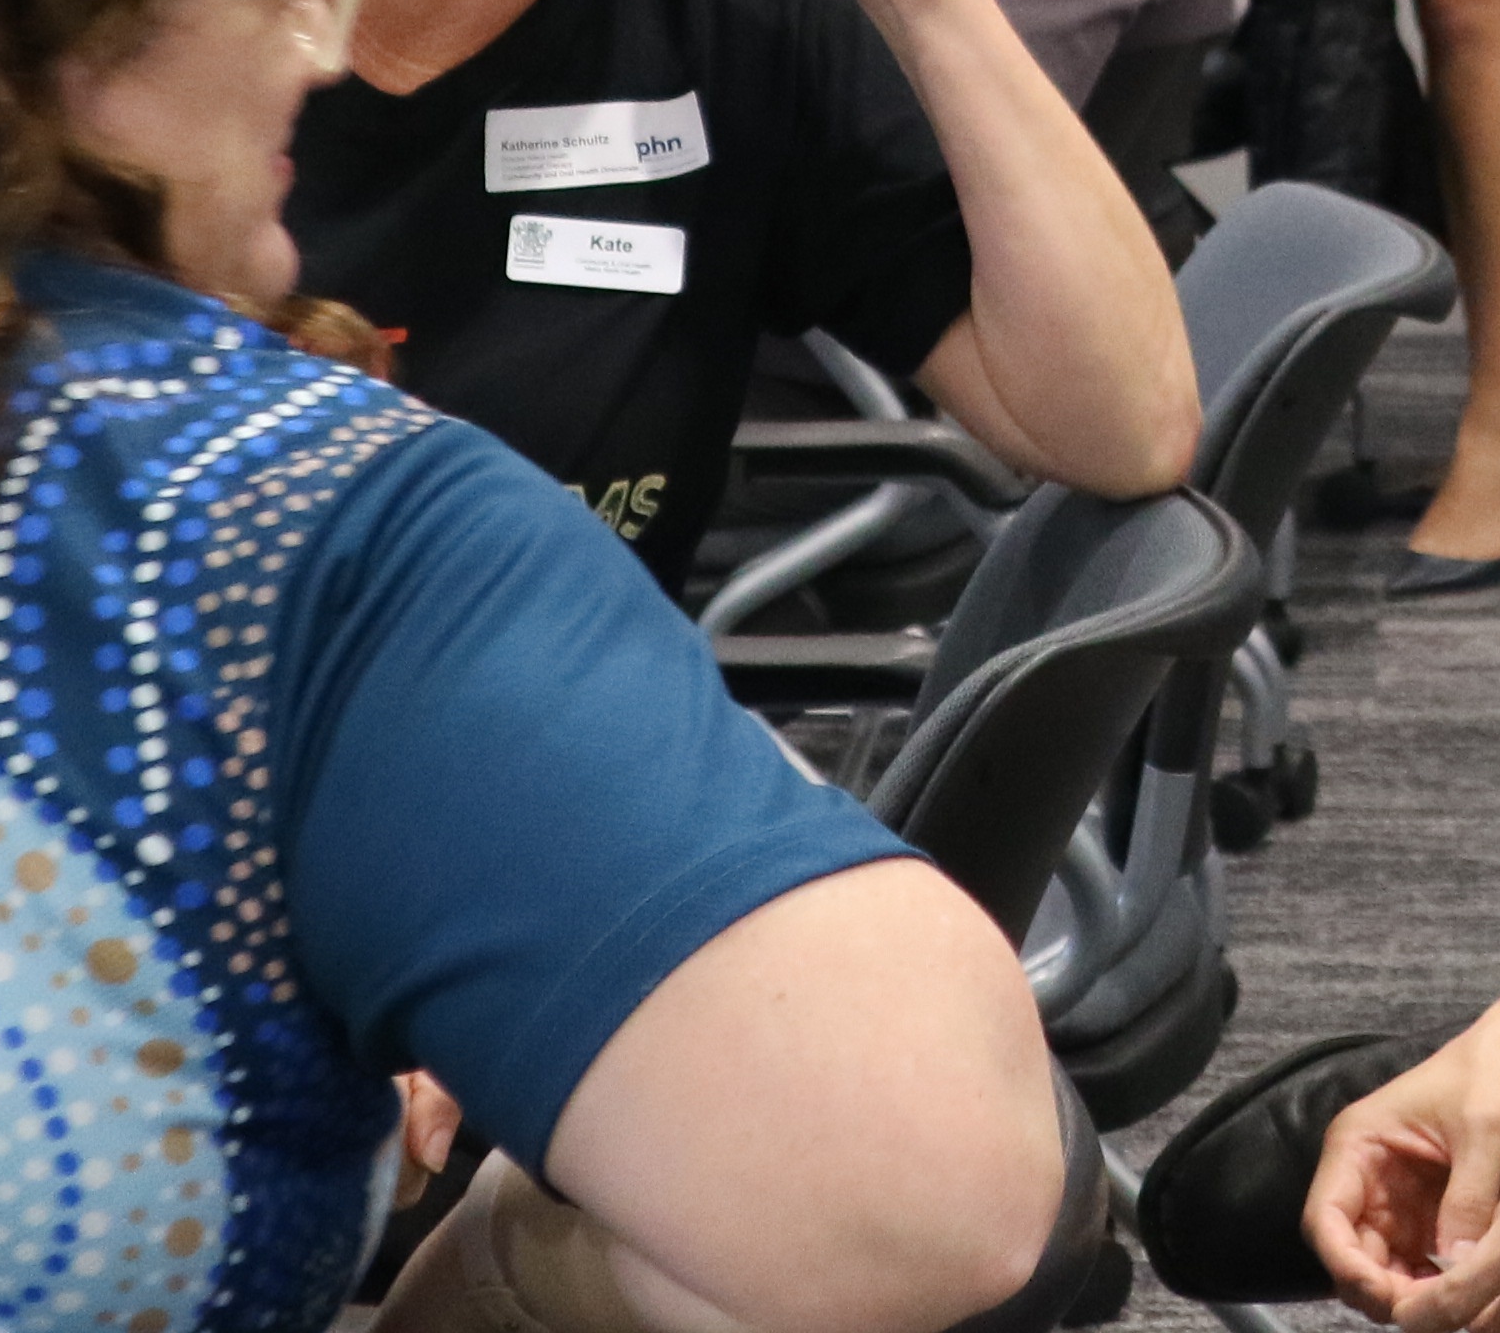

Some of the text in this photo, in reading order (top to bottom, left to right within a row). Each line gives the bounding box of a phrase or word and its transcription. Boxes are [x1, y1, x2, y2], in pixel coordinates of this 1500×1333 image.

[501, 135, 609, 151] Katherine Schultz
[635, 135, 682, 162] phn
[590, 235, 633, 253] Kate
